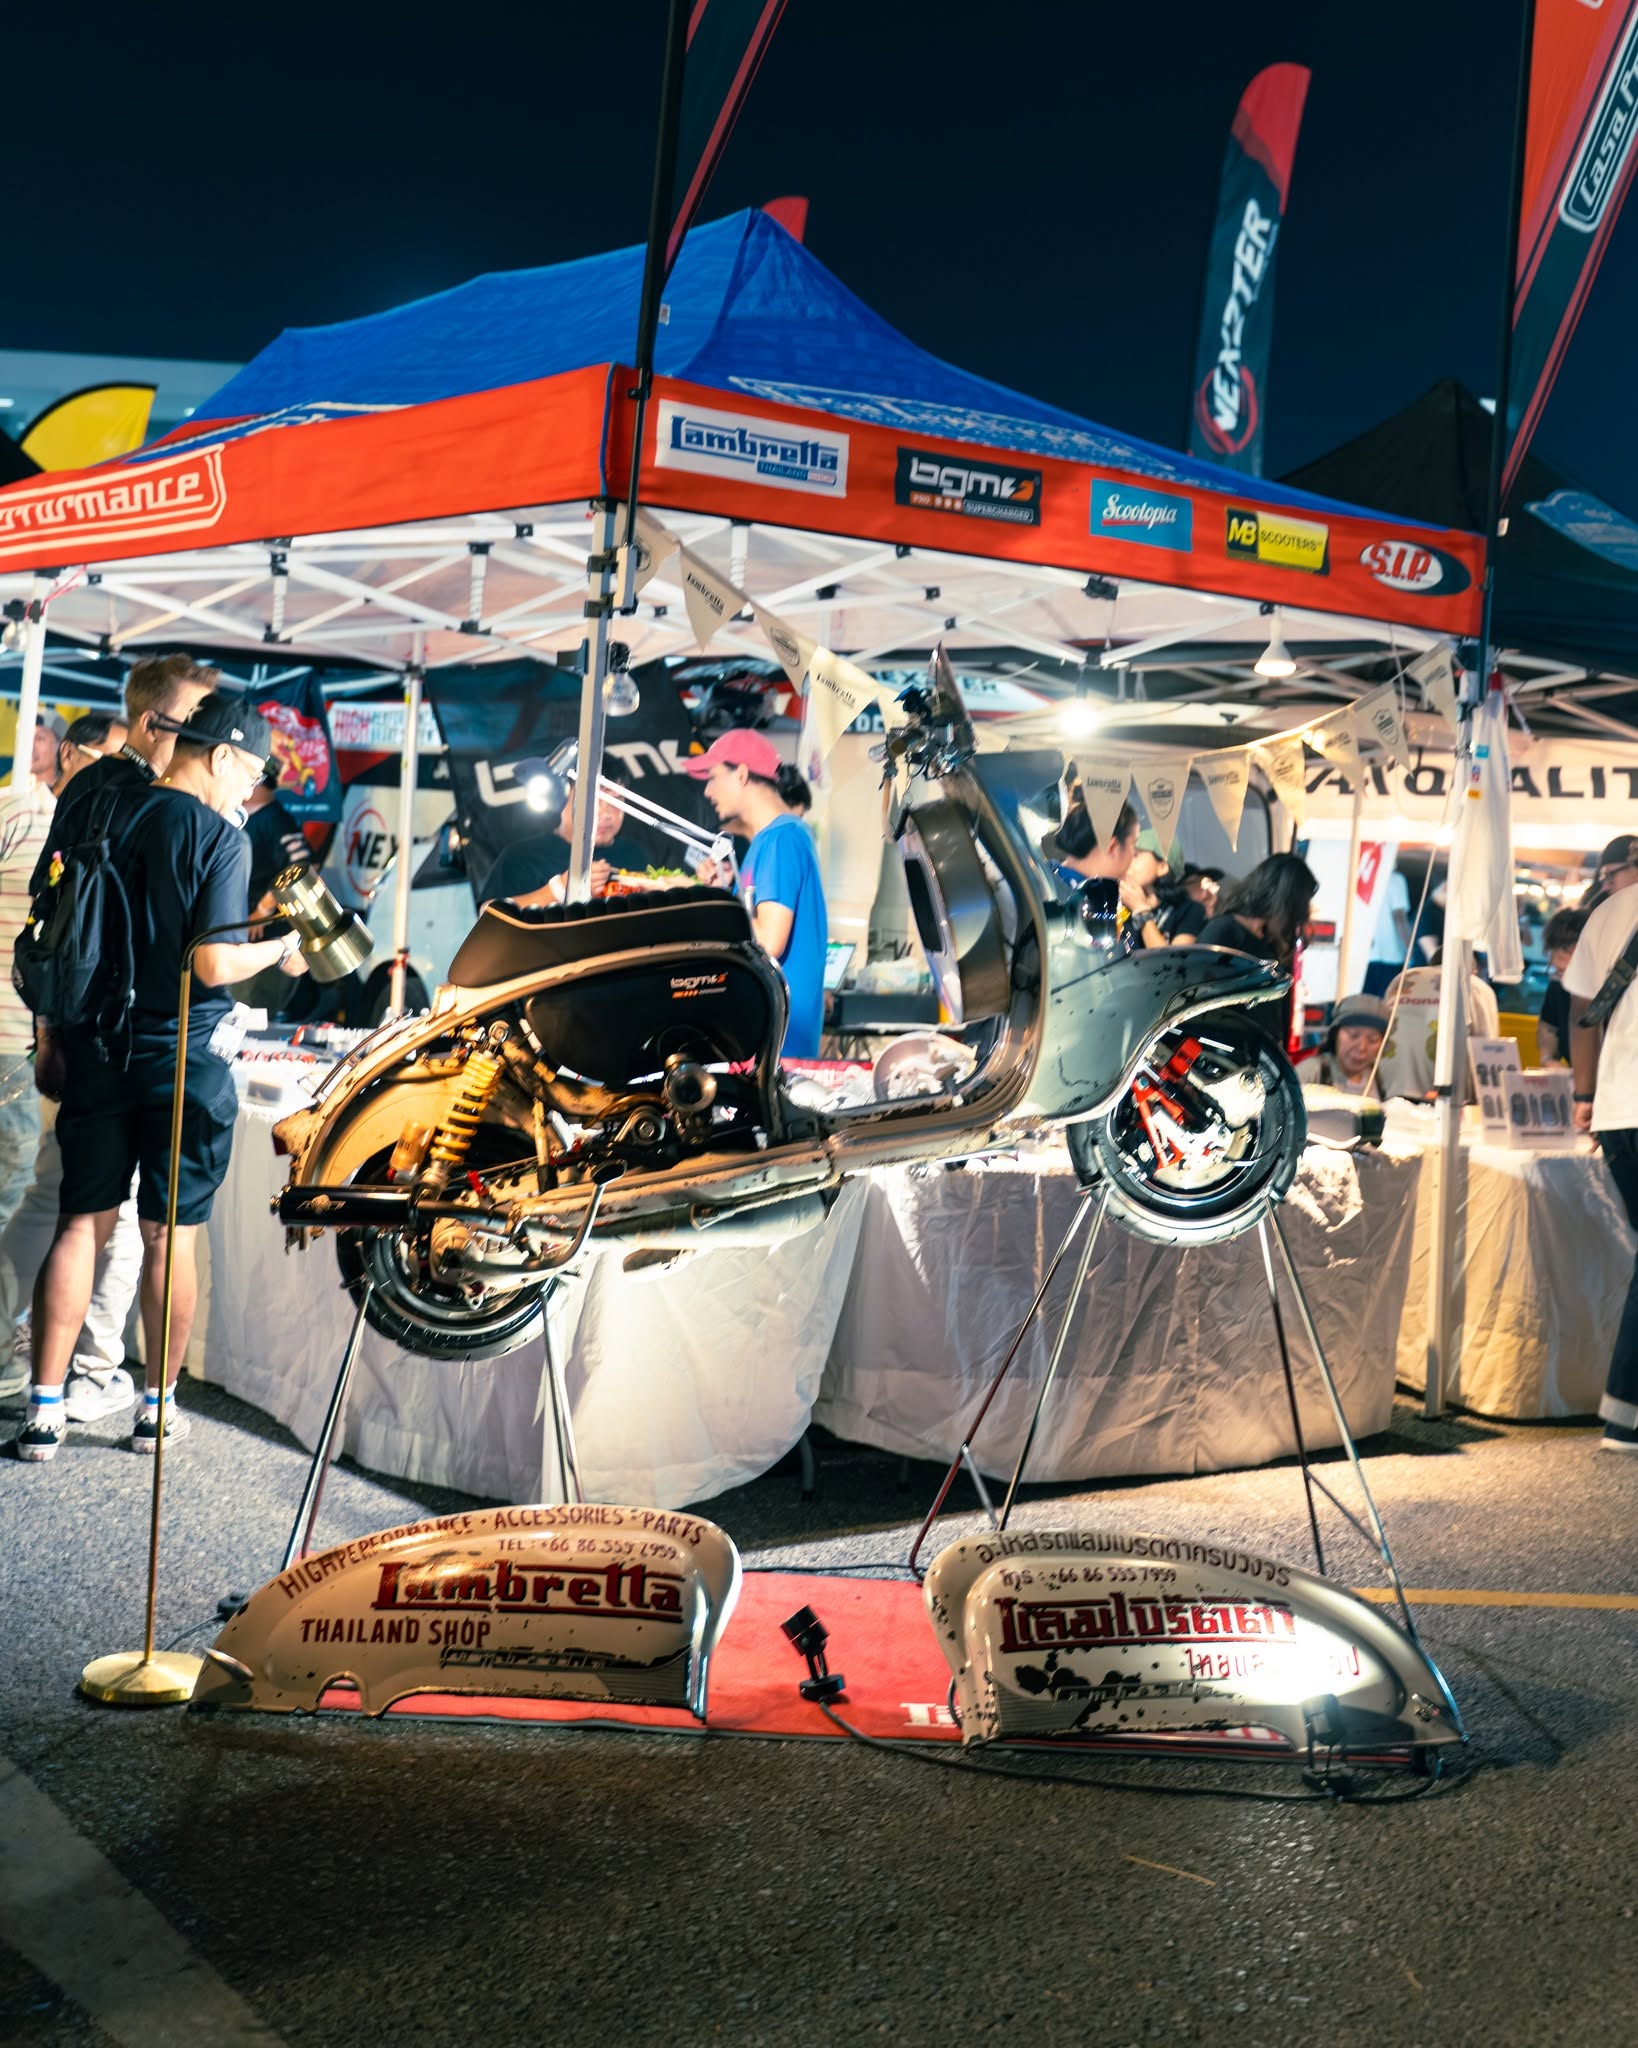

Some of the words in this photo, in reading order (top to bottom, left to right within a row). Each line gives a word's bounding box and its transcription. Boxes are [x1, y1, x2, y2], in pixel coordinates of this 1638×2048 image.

[1579, 107, 1628, 208] Casa
[1213, 198, 1271, 431] NEXZTER
[670, 415, 839, 472] Lambretta
[1102, 494, 1178, 530] Scootopia
[1228, 517, 1258, 546] MB
[1260, 530, 1318, 552] SCOOTERS
[495, 1507, 625, 1531] ACCESSORIES
[641, 1511, 708, 1546] PARTS
[371, 1558, 684, 1624] Lambretta
[301, 1618, 420, 1644] THAILAND
[427, 1618, 491, 1648] SHOP
